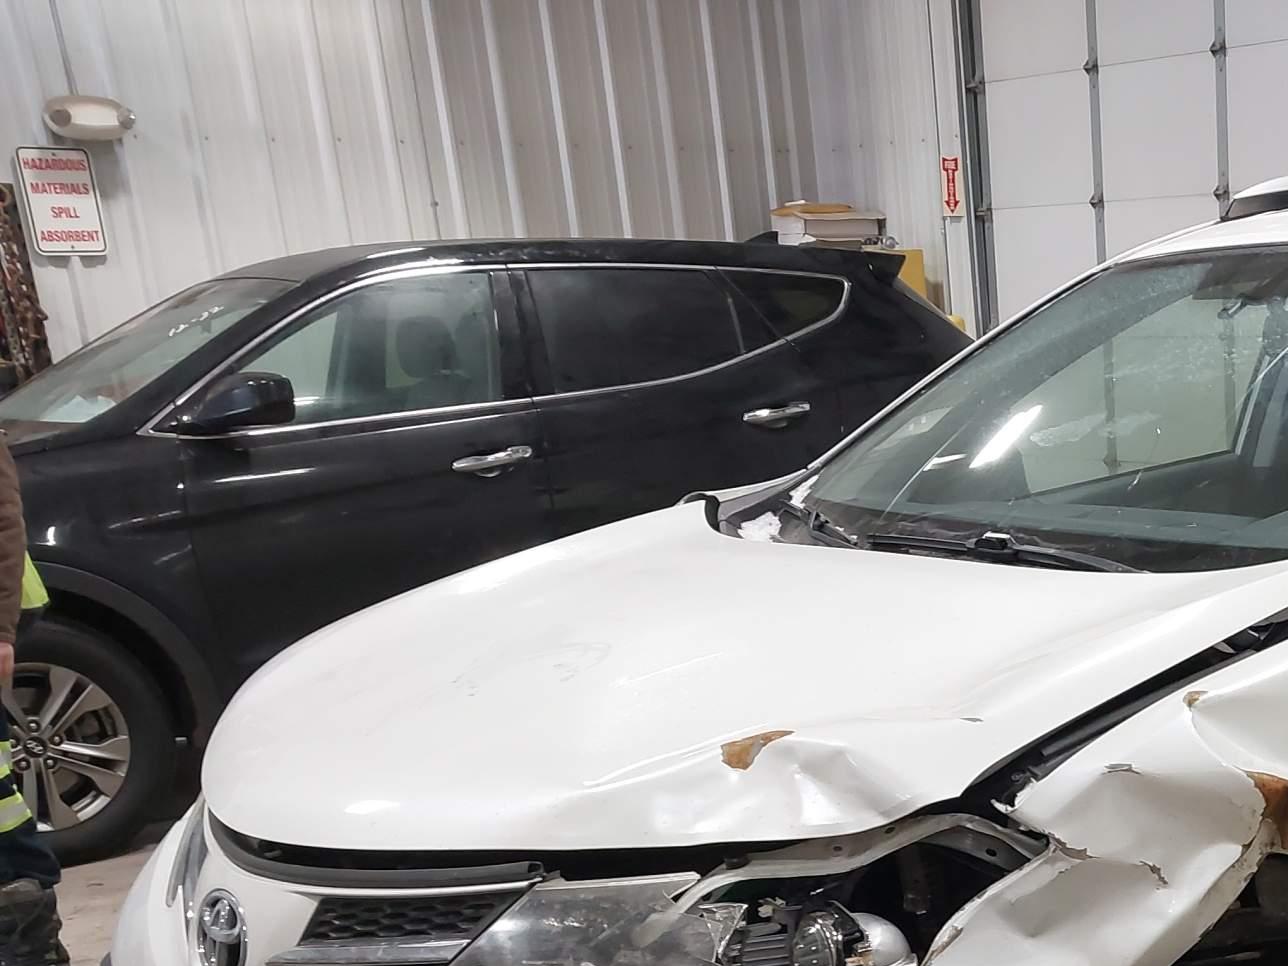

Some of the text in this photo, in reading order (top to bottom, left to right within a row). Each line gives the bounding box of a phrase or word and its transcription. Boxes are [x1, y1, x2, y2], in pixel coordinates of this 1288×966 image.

[22, 157, 87, 171] HAZARDOUS
[30, 182, 90, 195] MATERIALS
[51, 206, 80, 219] SPILL
[40, 230, 100, 242] ABSORBENT
